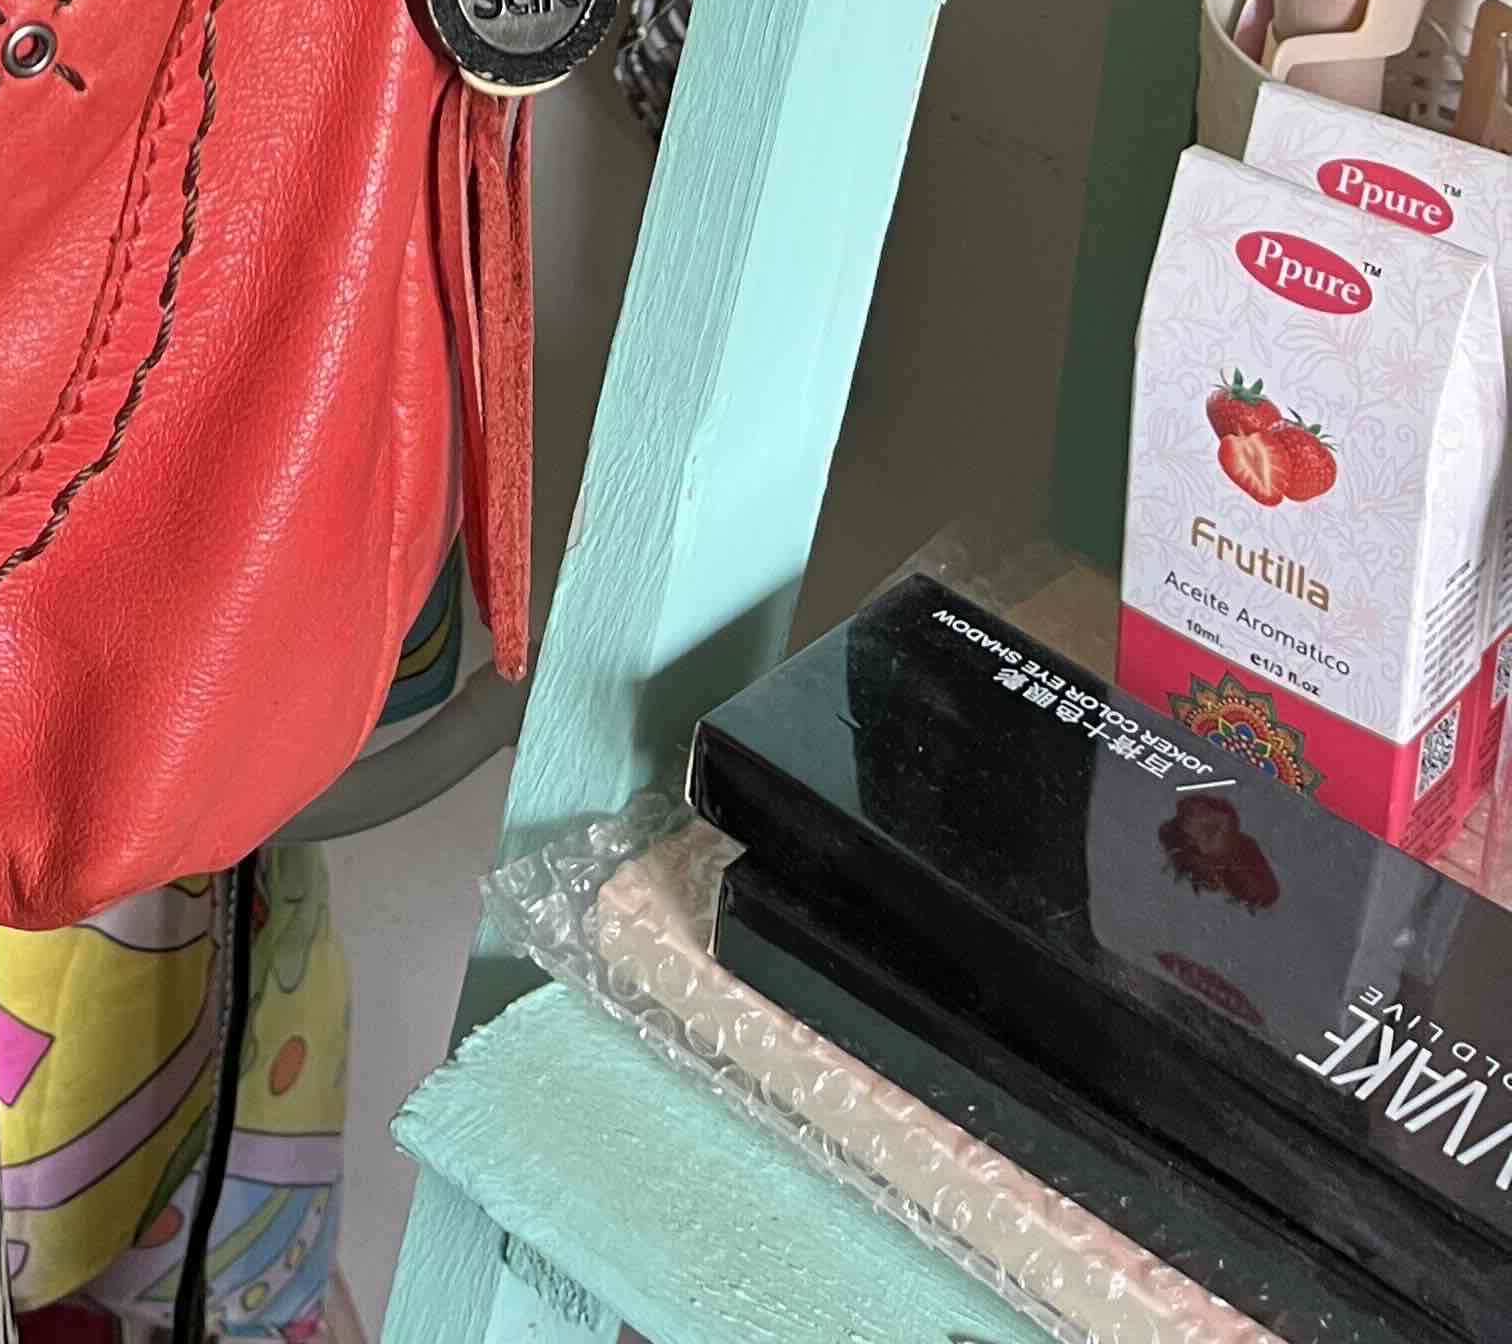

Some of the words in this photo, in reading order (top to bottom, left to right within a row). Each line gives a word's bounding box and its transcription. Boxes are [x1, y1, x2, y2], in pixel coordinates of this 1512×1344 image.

[1336, 163, 1442, 225] Ppure
[1255, 236, 1361, 305] Ppure
[1191, 516, 1329, 612] Frutilla
[932, 610, 1022, 664] SHADOW
[1164, 570, 1230, 616] Aceite
[1236, 608, 1350, 676] Aromatico
[1020, 660, 1066, 691] EYE
[1066, 685, 1139, 733] COLOR
[1140, 729, 1213, 775] JOKER
[1359, 985, 1444, 1043] LIVE
